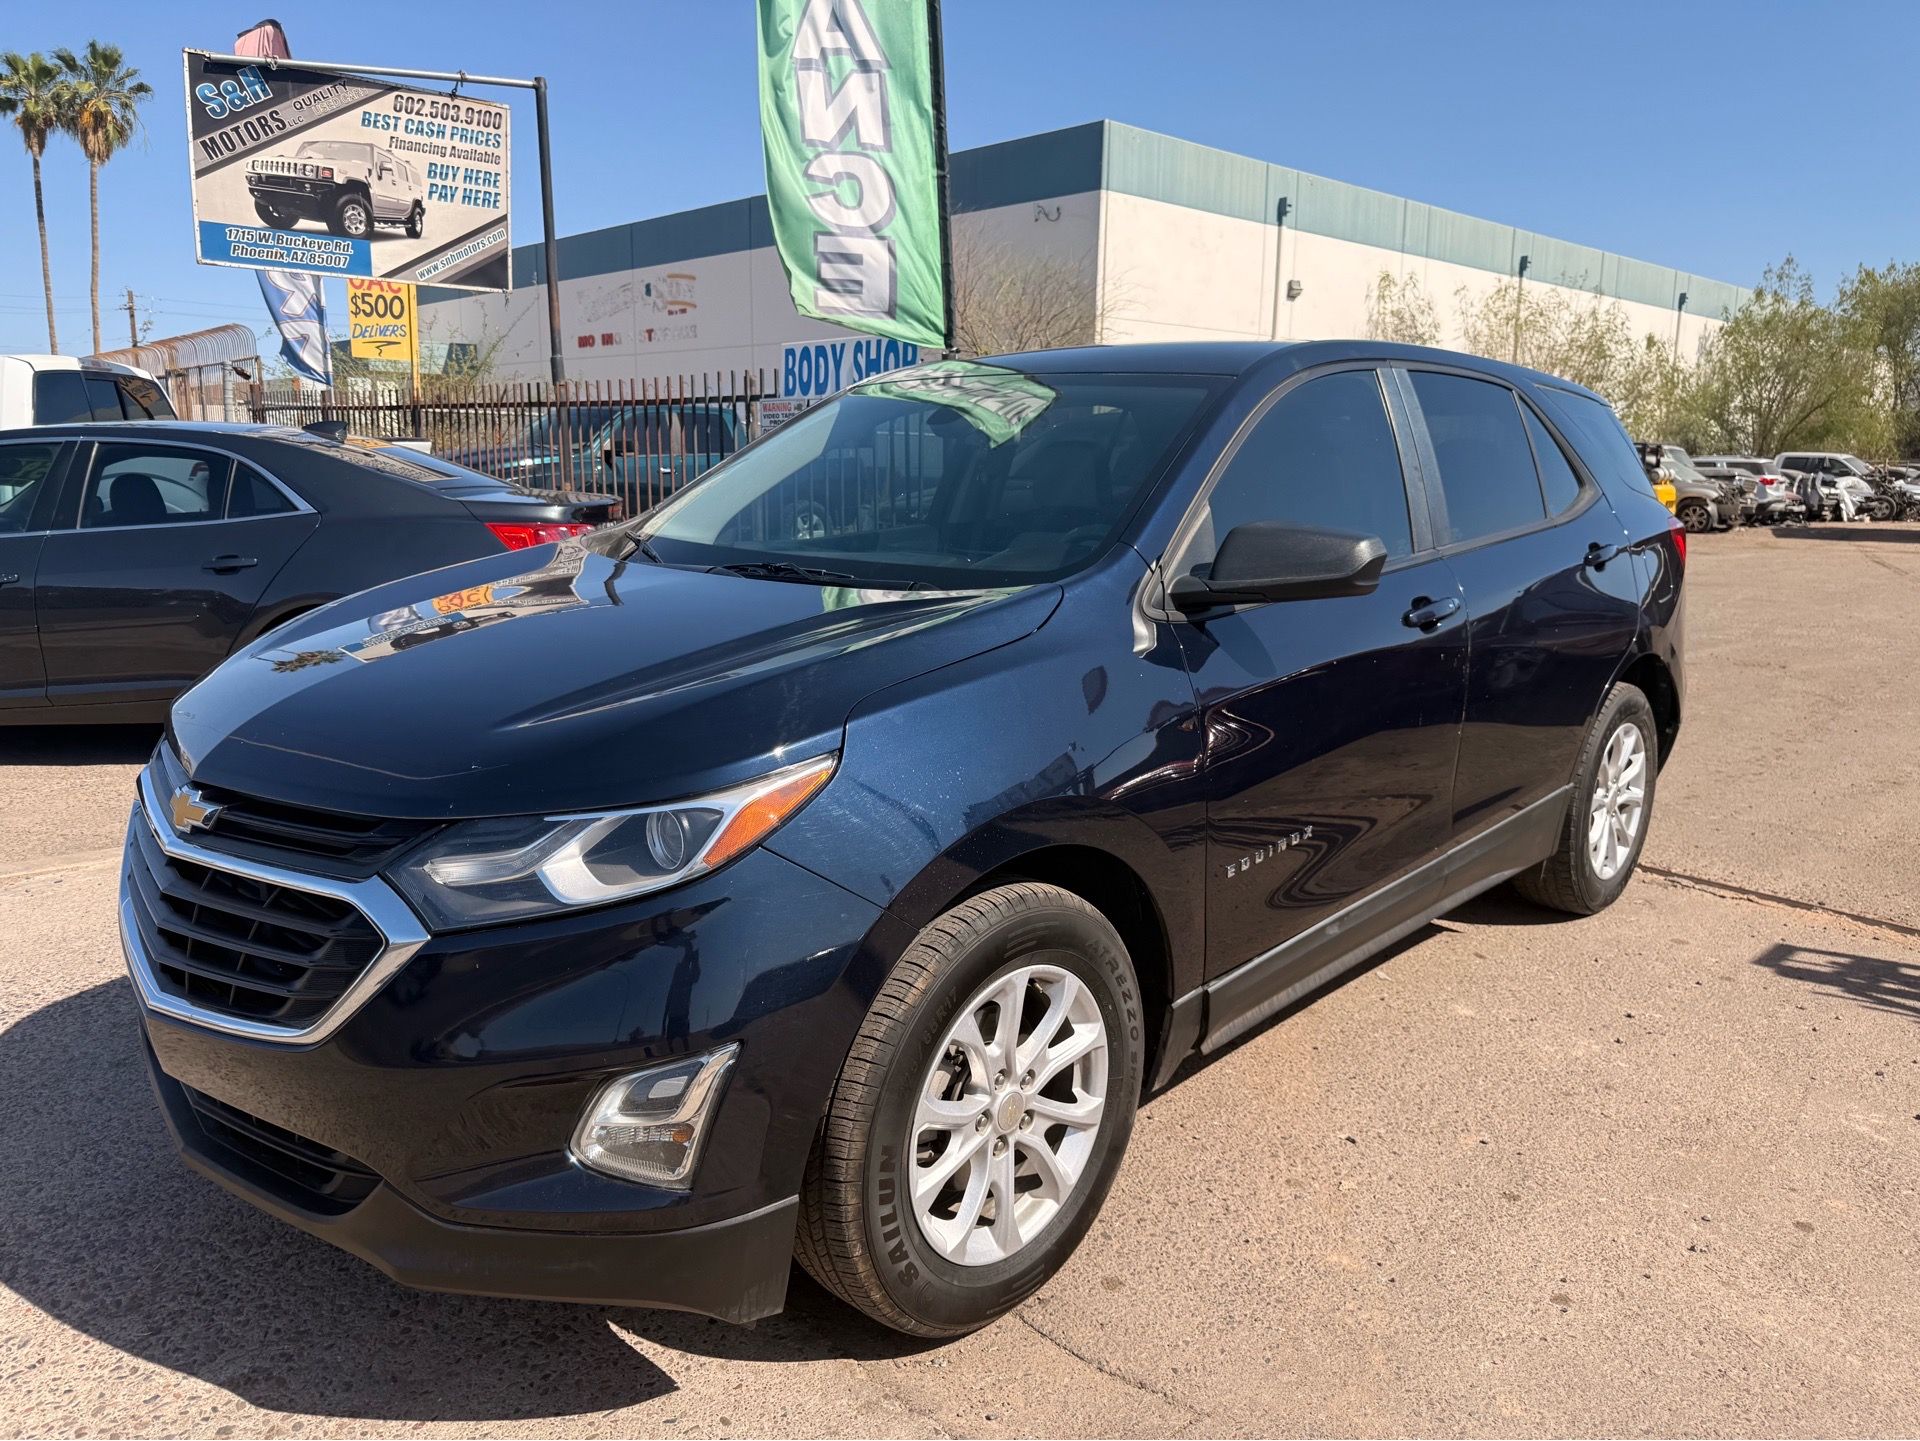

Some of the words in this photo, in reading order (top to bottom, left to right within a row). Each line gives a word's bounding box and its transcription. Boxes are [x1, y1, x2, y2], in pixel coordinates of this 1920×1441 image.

[196, 65, 272, 119] S&H
[293, 81, 348, 111] QUALITY
[311, 97, 341, 116] USED
[340, 88, 369, 104] CARS
[393, 95, 503, 130] 602.503.9100
[199, 109, 287, 161] MOTORS
[288, 116, 304, 127] LLC
[361, 111, 401, 132] BEST
[404, 118, 447, 140] CA$H
[450, 126, 502, 149] PRICES
[389, 136, 447, 158] Financing
[449, 146, 501, 165] Available
[427, 162, 460, 182] BUY
[463, 168, 502, 189] HERE
[427, 183, 459, 203] PAY
[461, 188, 502, 209] HERE
[226, 228, 254, 242] 1715
[257, 232, 273, 244] W.
[276, 235, 333, 252] Buckeye
[334, 241, 353, 254] Rd.
[231, 244, 288, 262] Phoenix,
[290, 251, 308, 263] AZ
[309, 253, 349, 267] 85007
[416, 228, 506, 280] www.snhmotors.com
[350, 293, 405, 320] $500
[784, 343, 846, 397] BODY
[762, 402, 792, 413] WARNING
[1226, 825, 1313, 878] EQUINOX
[878, 1145, 920, 1287] SAILUN
